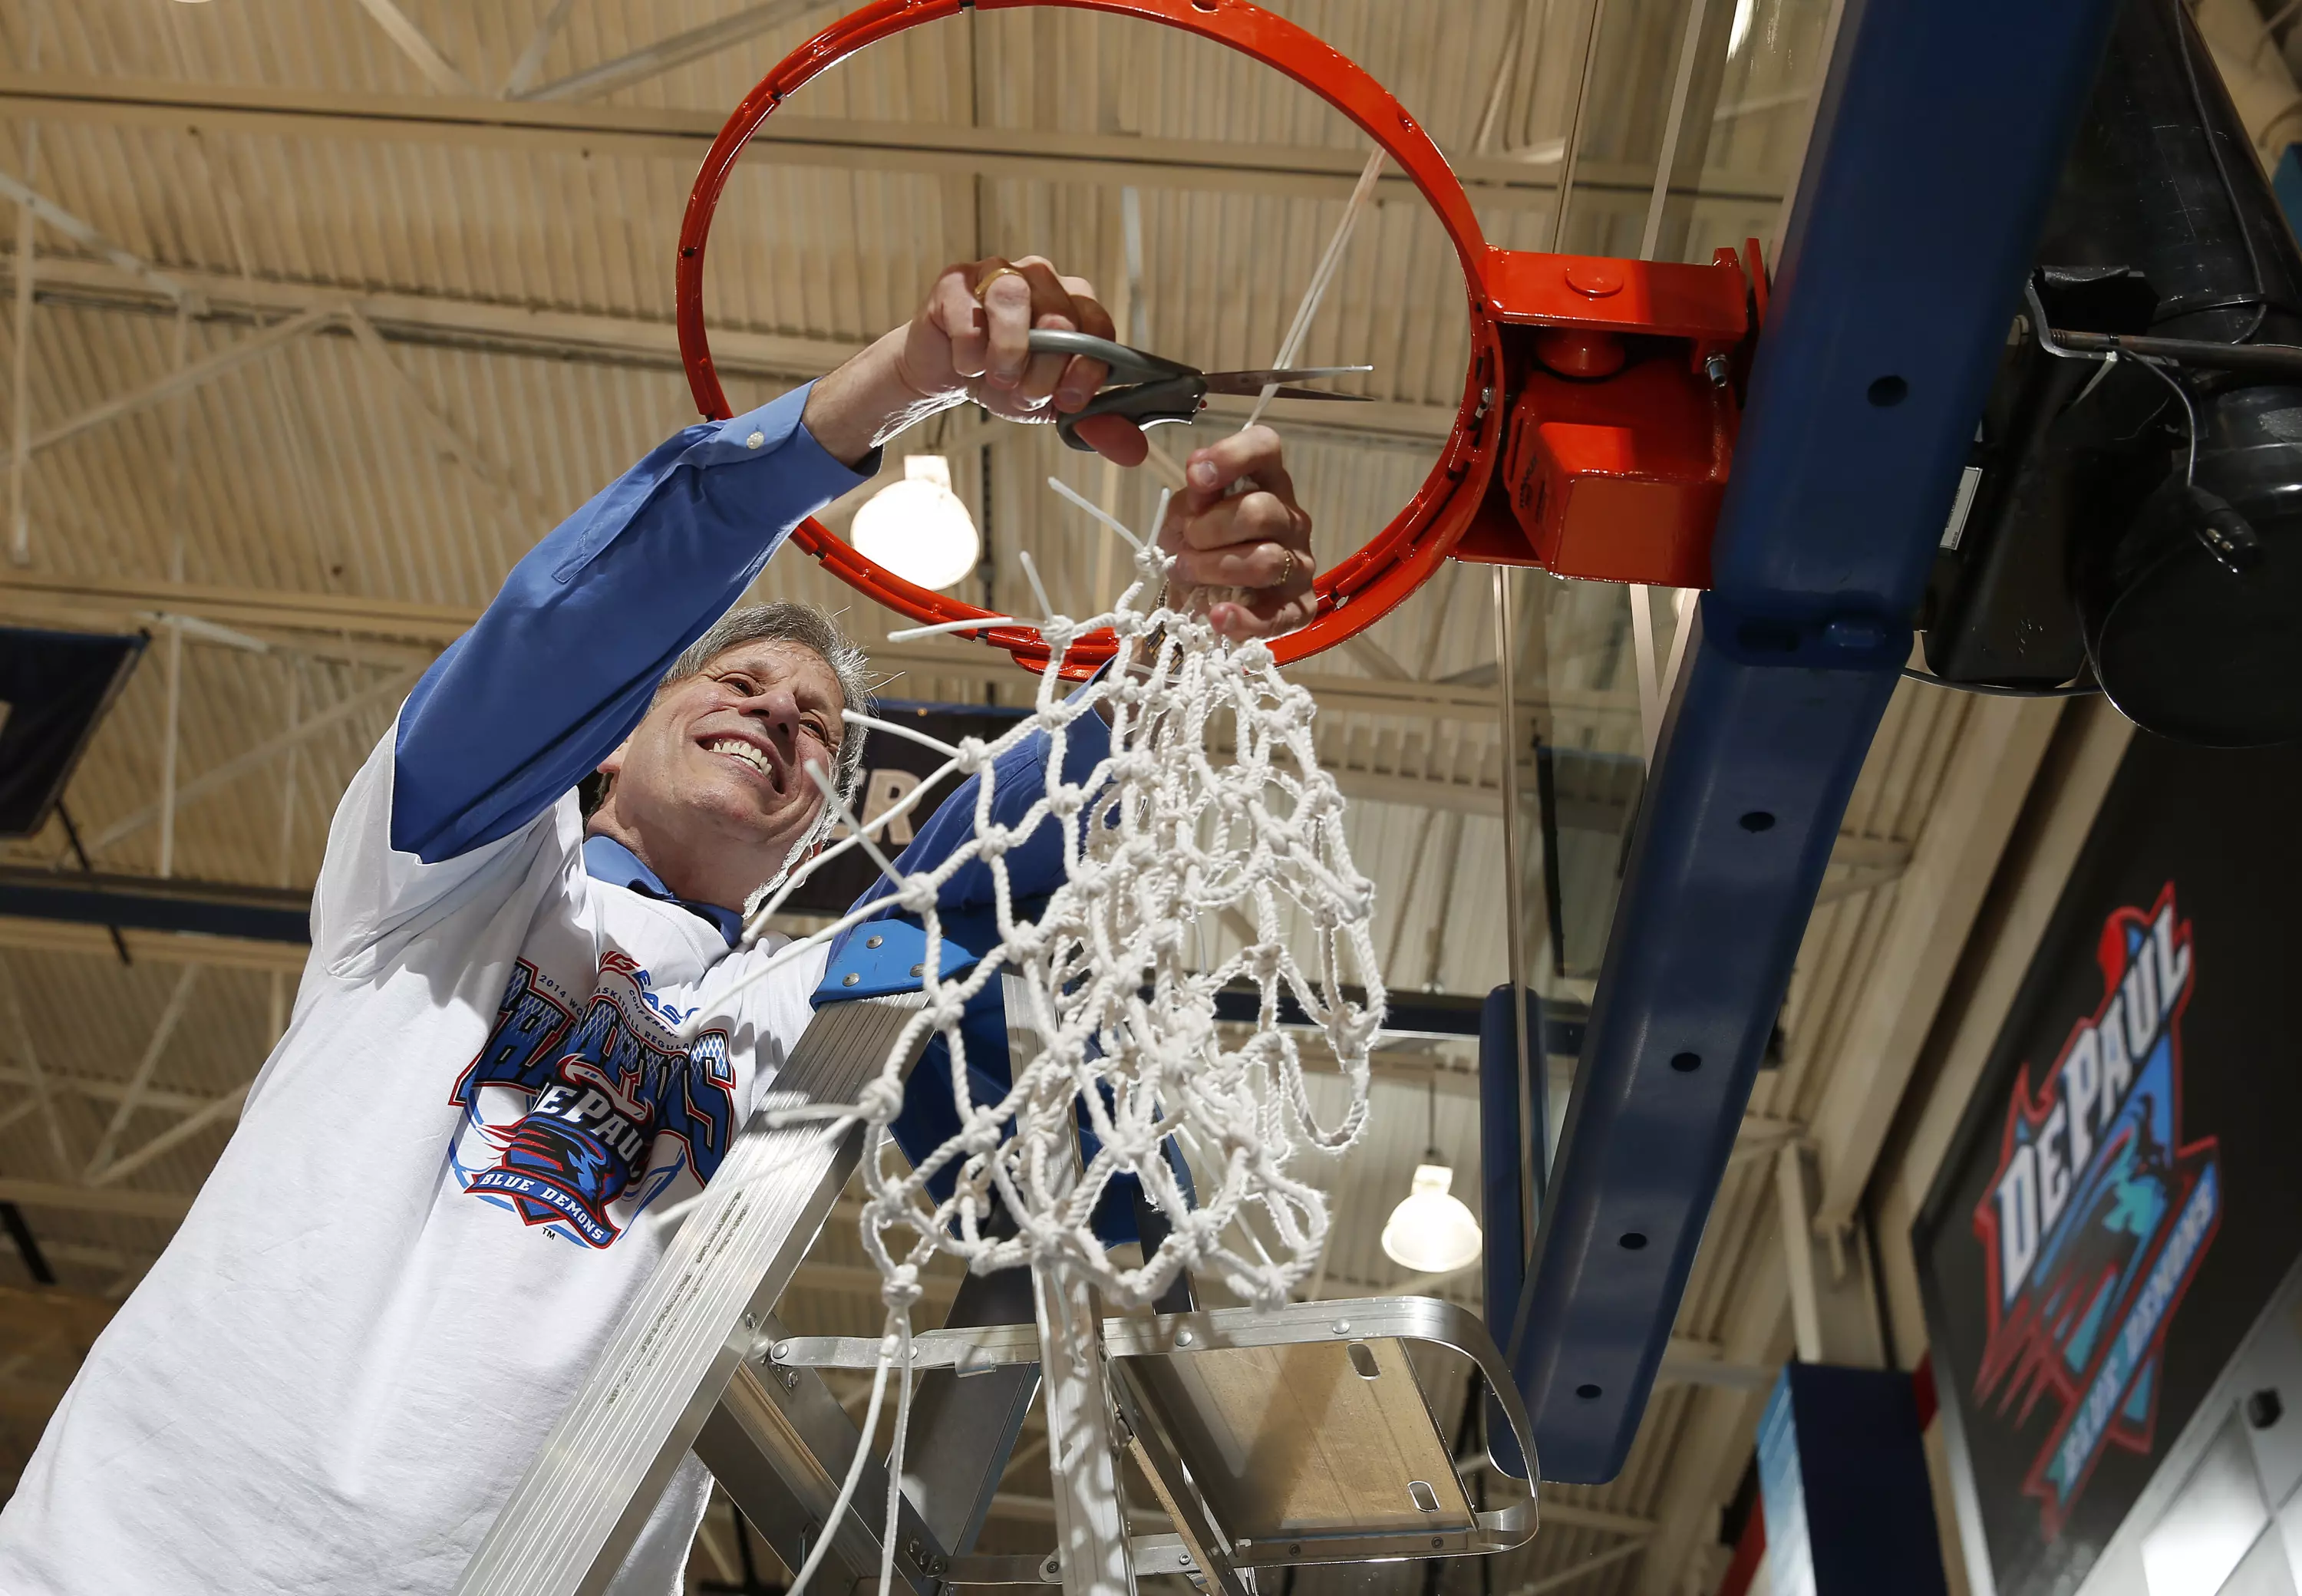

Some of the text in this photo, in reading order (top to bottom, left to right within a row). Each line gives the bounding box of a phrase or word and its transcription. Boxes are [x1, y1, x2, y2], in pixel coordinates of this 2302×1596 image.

[539, 974, 566, 998] 2014
[592, 988, 638, 1032] ASKETBALL
[645, 1030, 690, 1050] REGULA
[629, 990, 679, 1038] CONFEREN
[1998, 904, 2190, 1303] DEPAUL
[479, 1174, 605, 1241] BLUE DEMONS
[542, 1227, 556, 1240] TM
